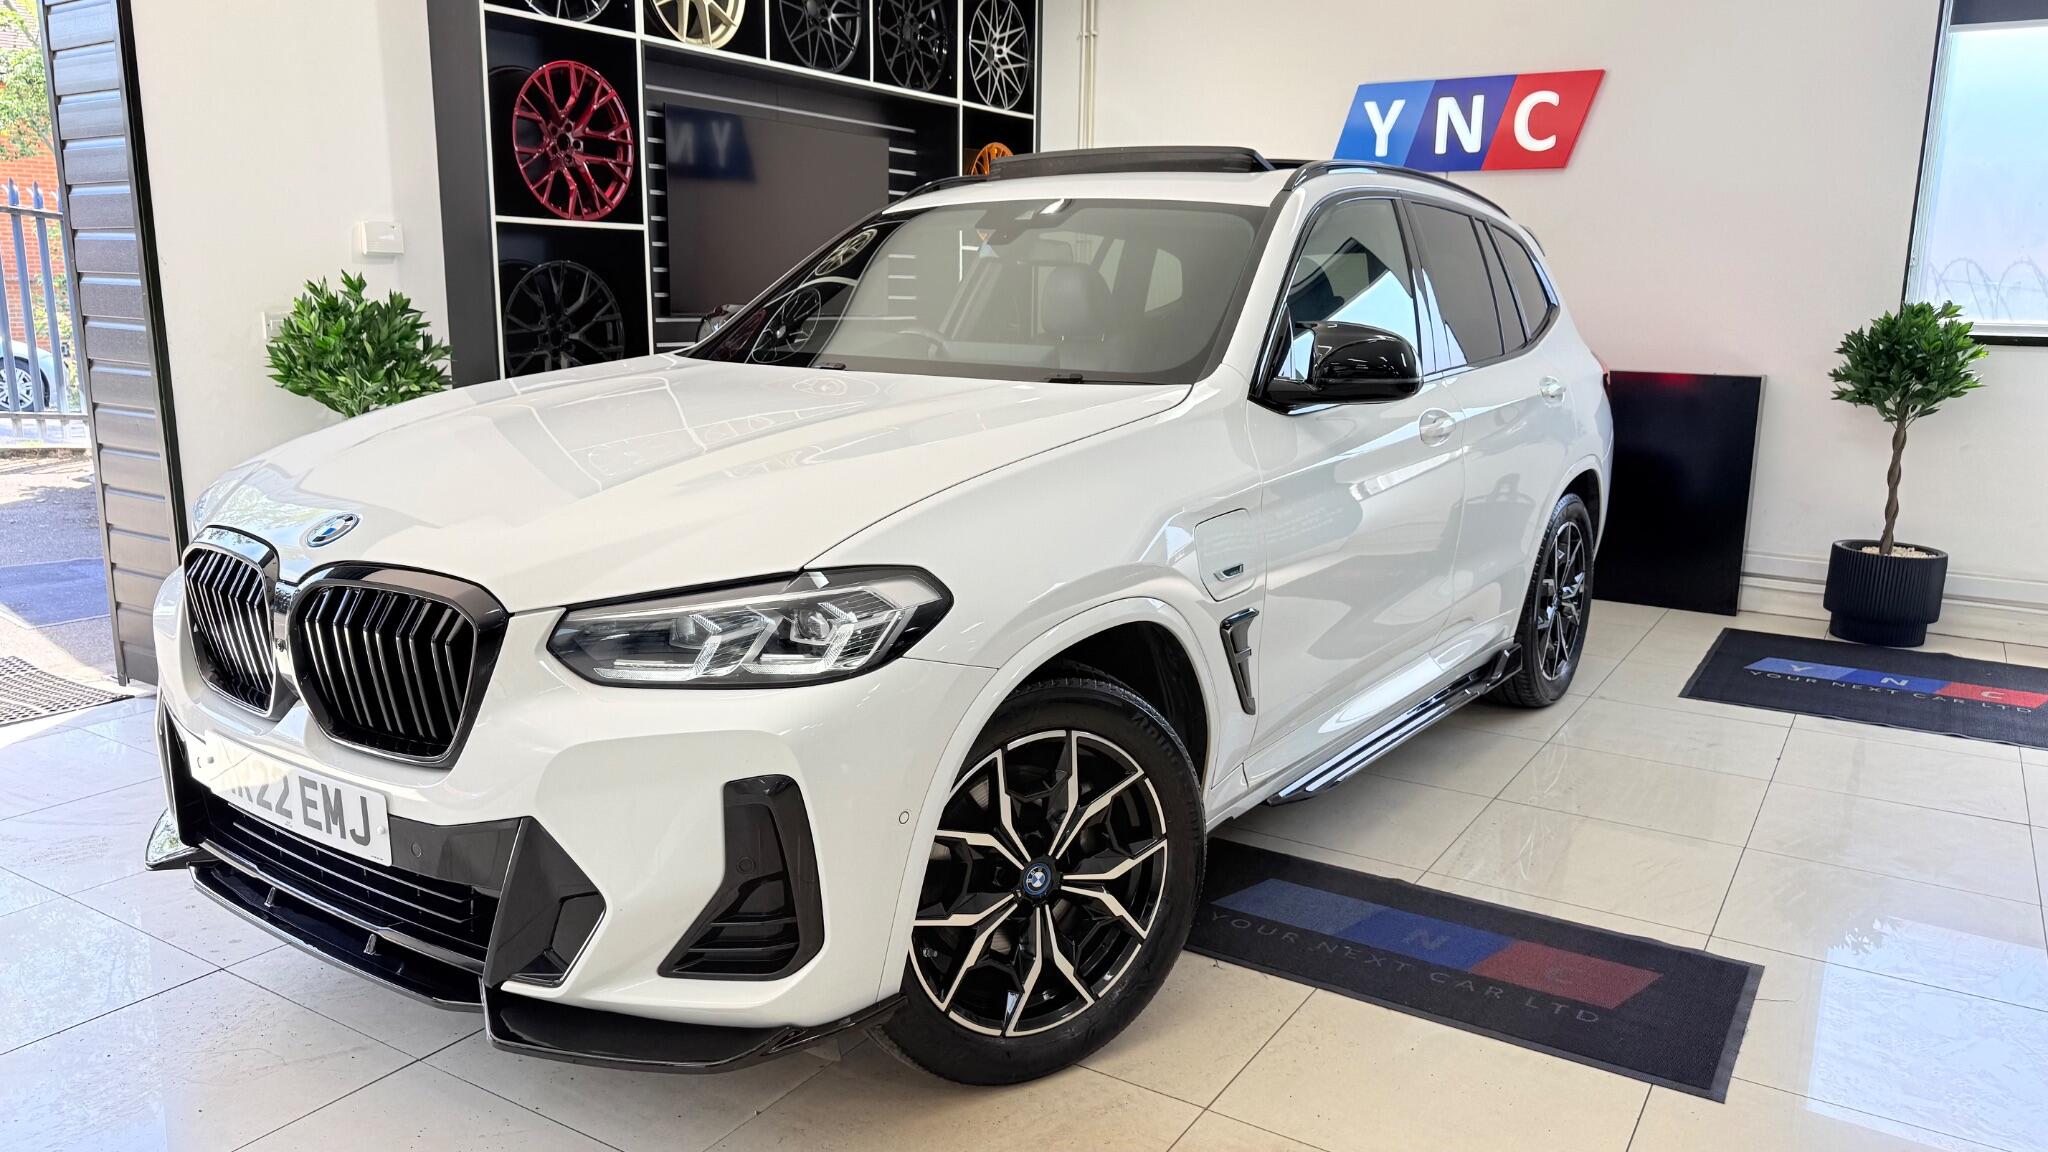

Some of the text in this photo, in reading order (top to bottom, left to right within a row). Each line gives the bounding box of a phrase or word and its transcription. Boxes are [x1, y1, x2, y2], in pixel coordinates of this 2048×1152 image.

[1364, 90, 1560, 157] YNC
[1750, 670, 2033, 714] YOUR NEXT CAR LTD
[298, 775, 371, 847] EMJ
[1211, 911, 1600, 1023] YOUR NEXT CAR LTD
